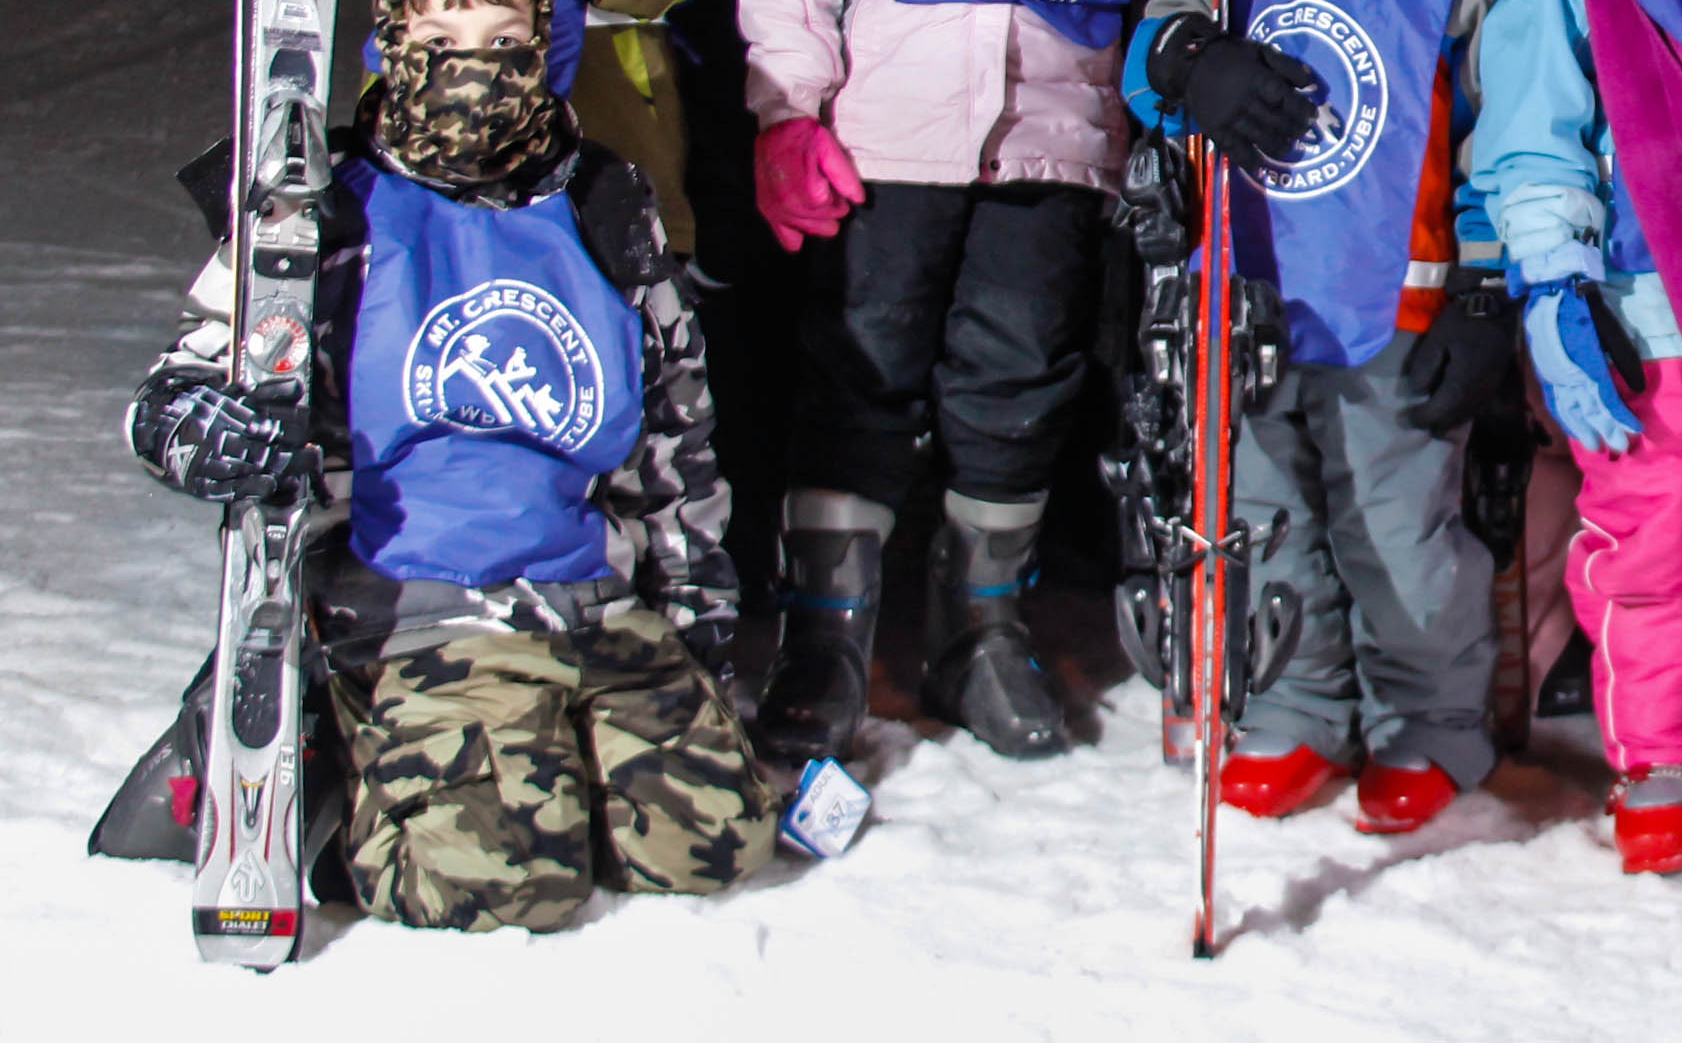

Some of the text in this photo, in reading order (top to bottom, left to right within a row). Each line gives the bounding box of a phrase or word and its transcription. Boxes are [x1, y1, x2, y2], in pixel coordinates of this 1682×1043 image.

[1252, 7, 1378, 86] T. CRESCENT
[1342, 104, 1377, 161] TUBE
[428, 288, 589, 365] MT. CRESCENT
